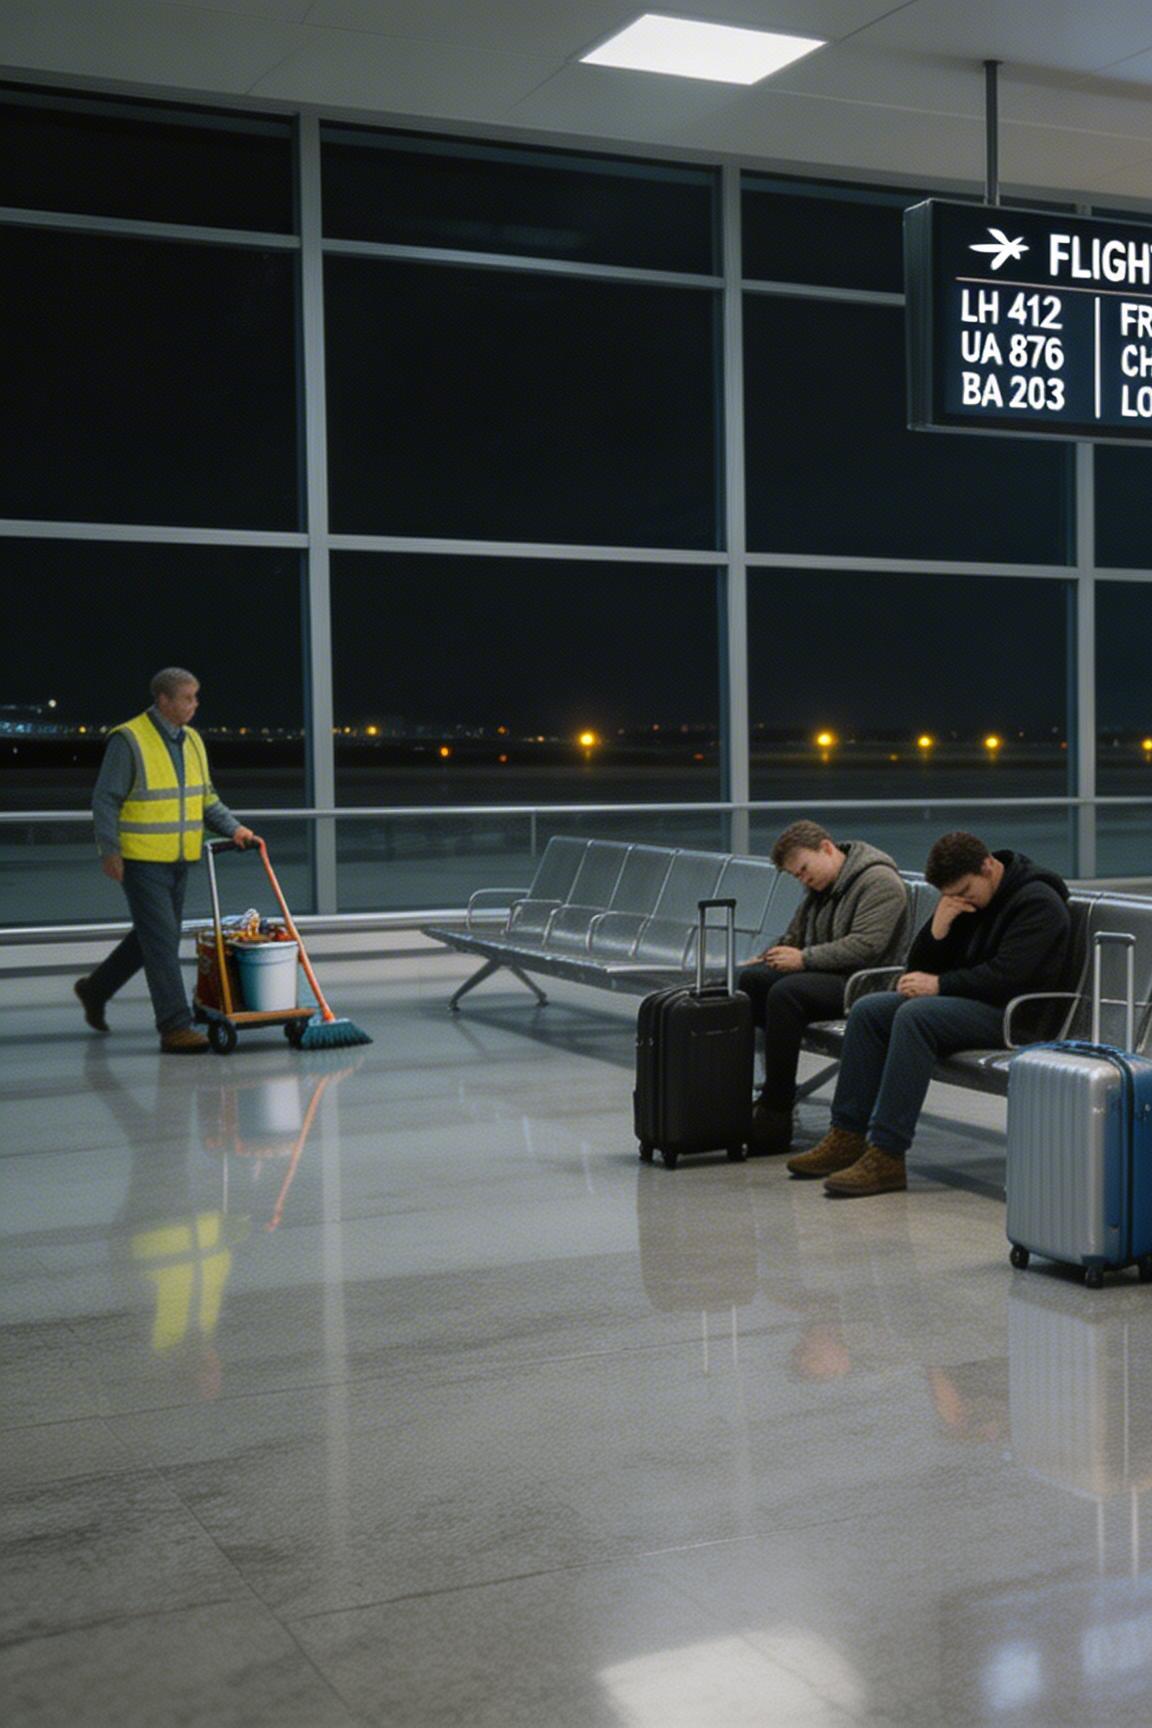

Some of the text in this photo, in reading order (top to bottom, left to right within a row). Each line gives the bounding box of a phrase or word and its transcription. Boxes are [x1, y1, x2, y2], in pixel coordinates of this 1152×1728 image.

[961, 289, 999, 325] LH
[1007, 292, 1063, 330] 412
[961, 330, 1003, 366] UA
[1008, 333, 1065, 371] 876
[961, 371, 1004, 408] BA
[1008, 375, 1065, 411] 203
